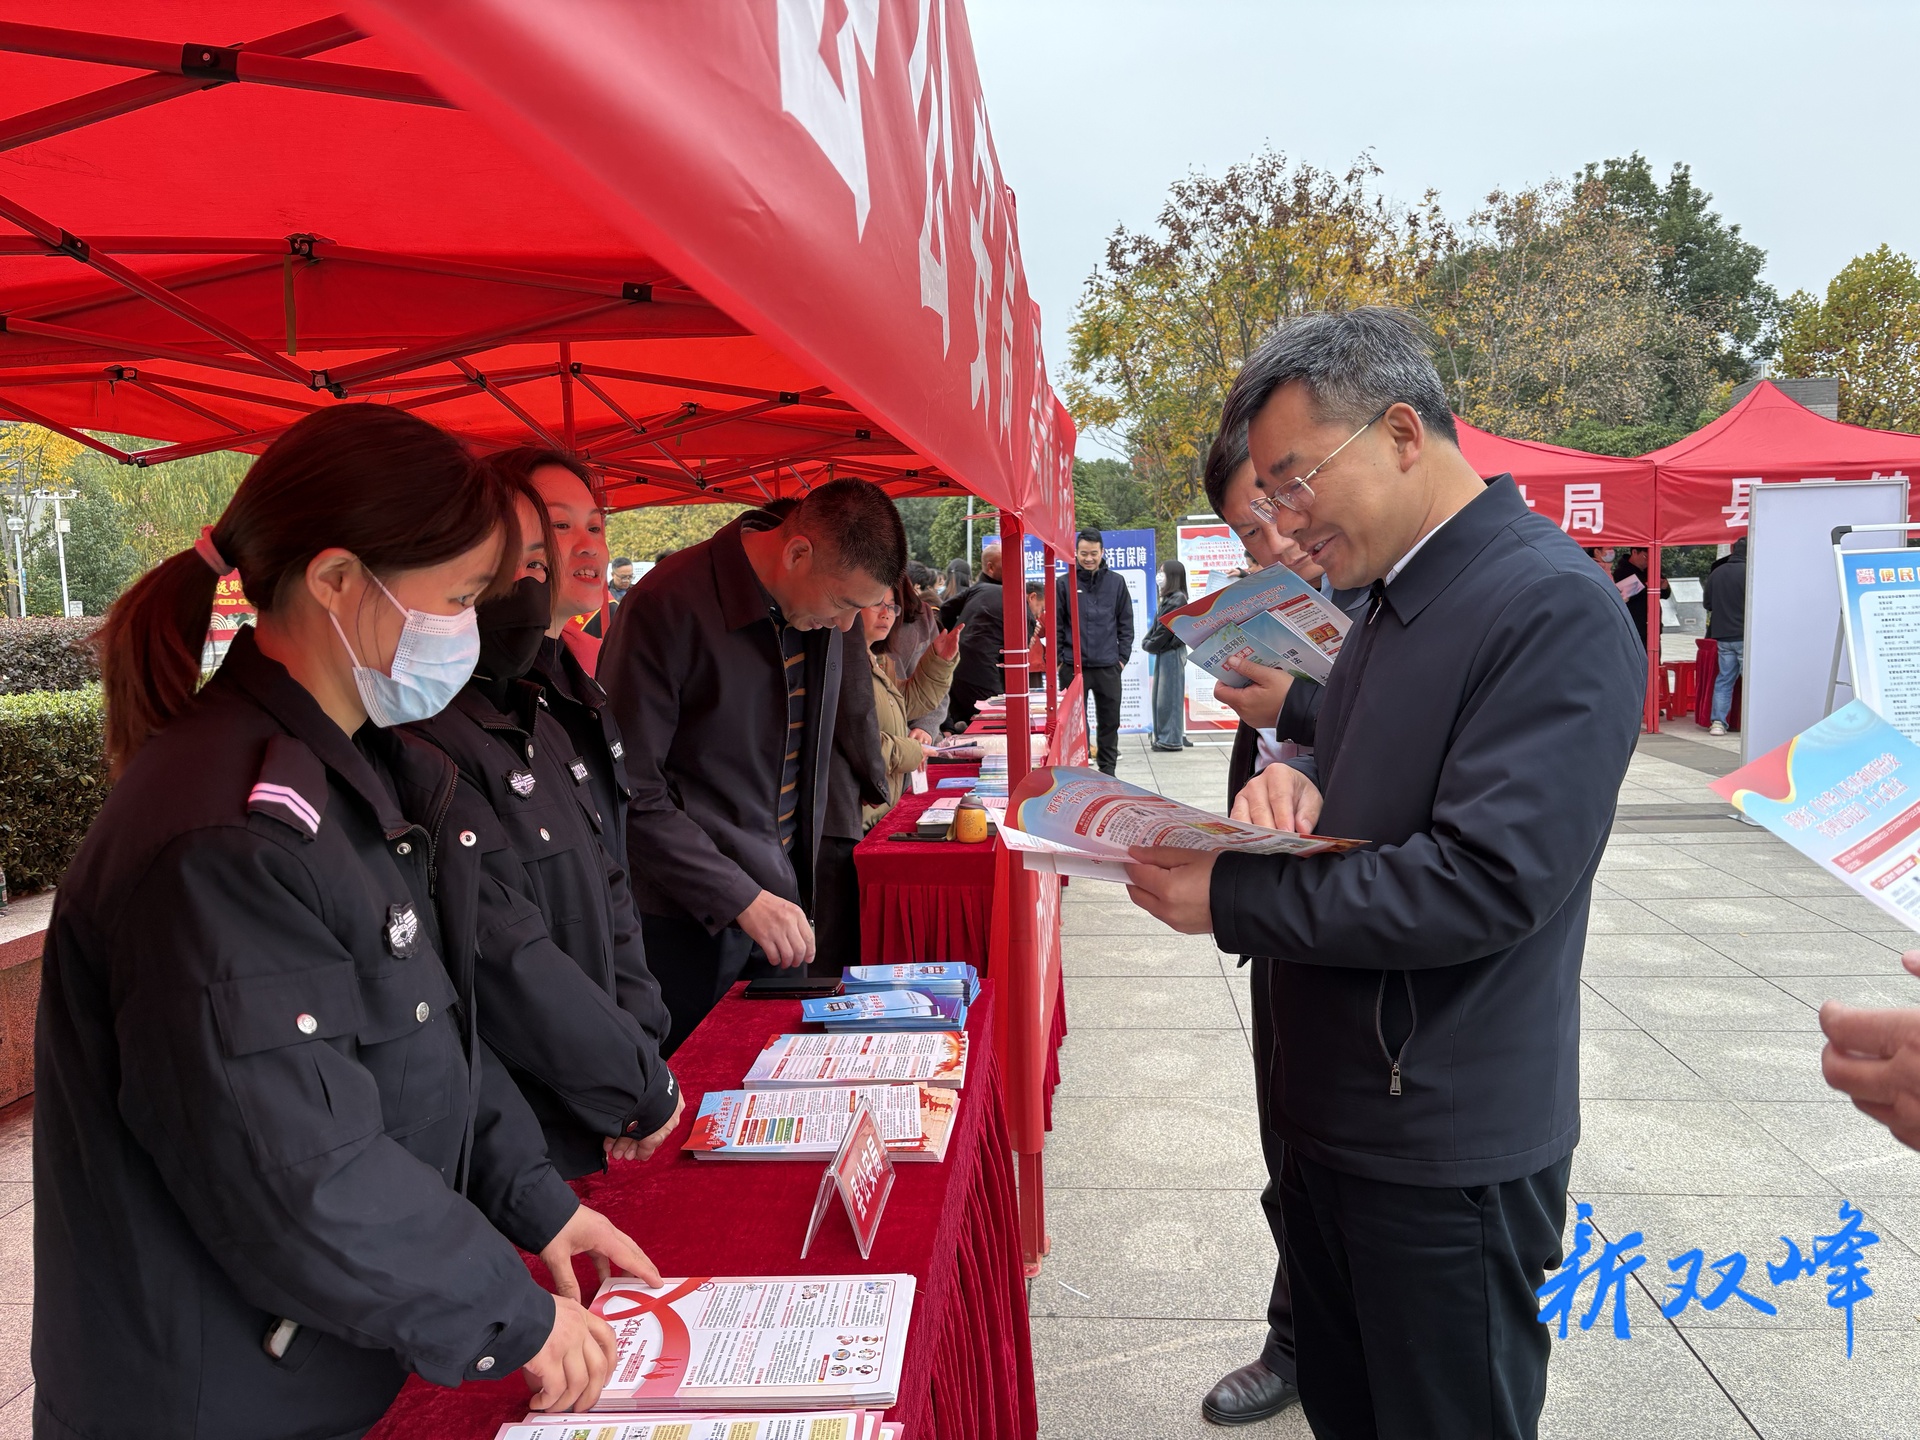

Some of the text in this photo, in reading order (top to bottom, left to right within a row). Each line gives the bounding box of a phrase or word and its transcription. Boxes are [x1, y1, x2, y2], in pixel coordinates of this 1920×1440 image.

[1519, 483, 1604, 535] 局
[1879, 568, 1920, 583] 便民
[1203, 634, 1248, 669] 甲型流感预防
[850, 1134, 884, 1222] 县公安局
